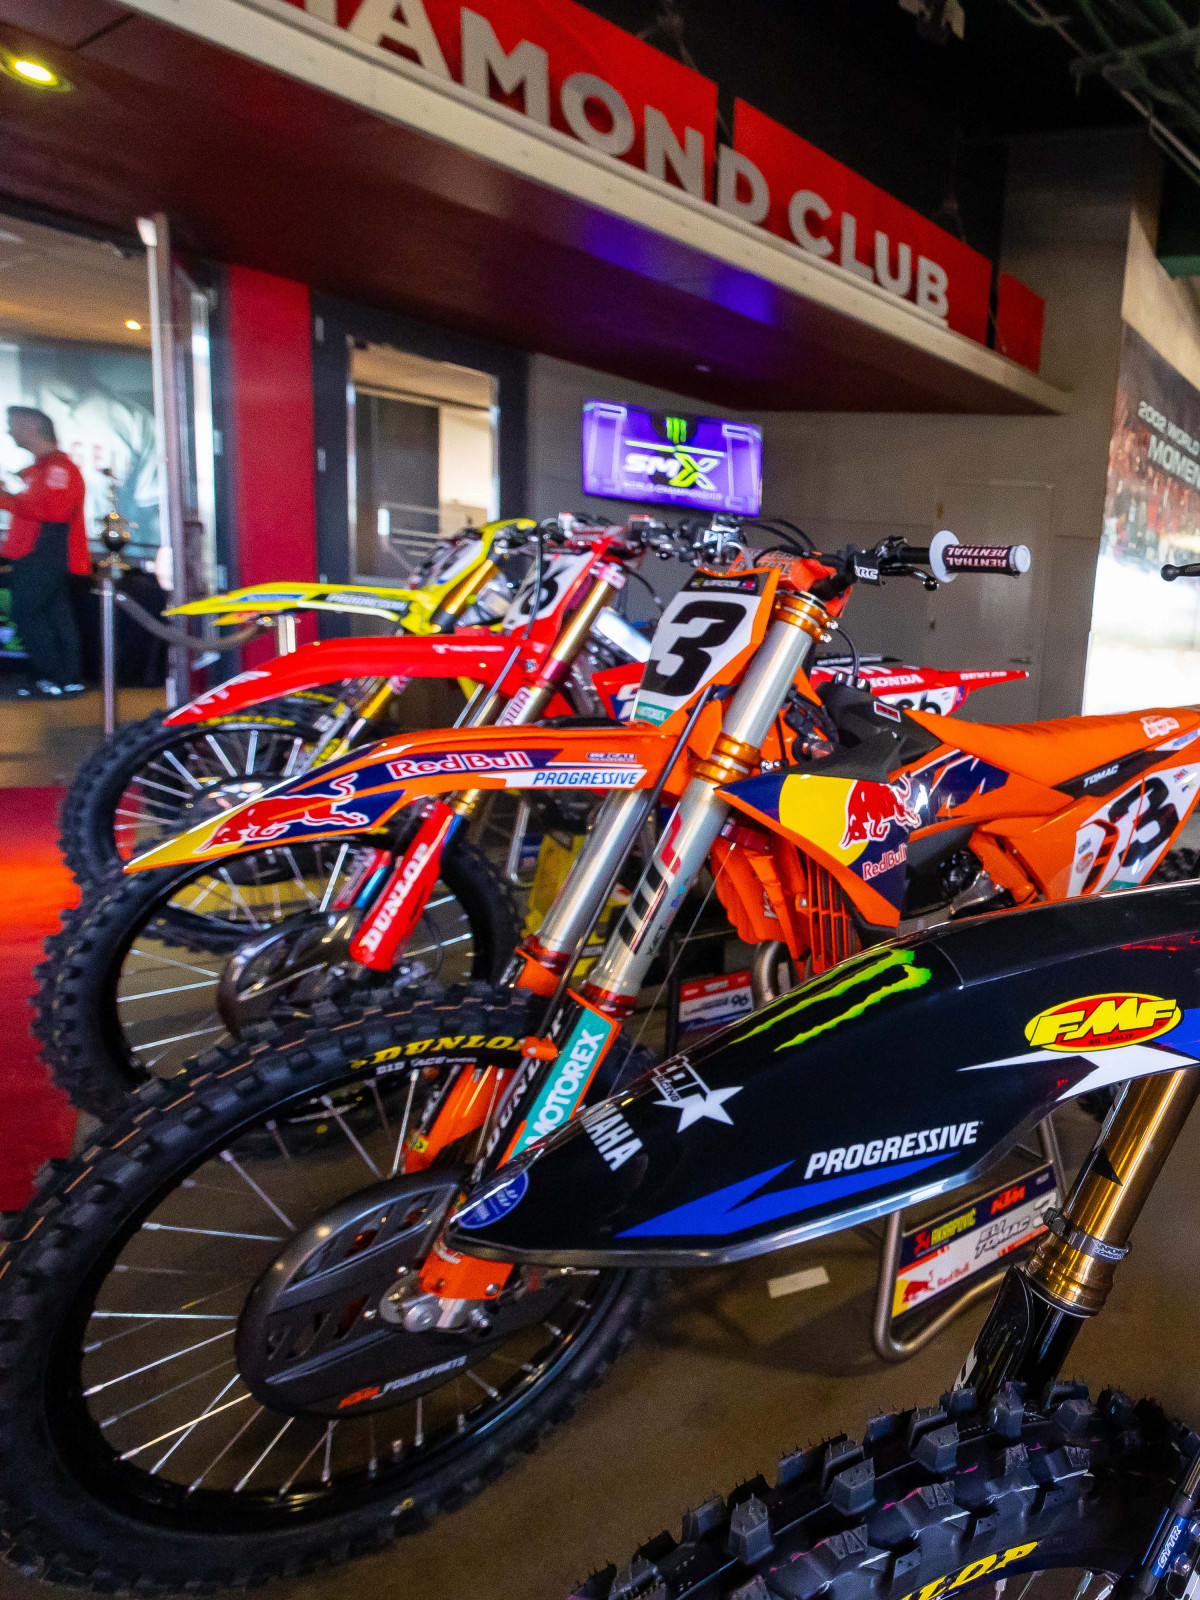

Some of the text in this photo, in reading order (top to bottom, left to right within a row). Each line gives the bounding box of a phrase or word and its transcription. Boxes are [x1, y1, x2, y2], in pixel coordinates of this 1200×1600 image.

[292, 0, 949, 319] AMOND CLUB
[624, 450, 721, 491] SMX
[946, 556, 1007, 568] RENTHAL
[649, 600, 747, 697] 3
[387, 751, 533, 779] Red Bull
[532, 772, 638, 785] PROGRESSIVE
[1082, 764, 1120, 788] TOMAC
[862, 842, 907, 881] Red Bull
[359, 842, 428, 952] DUNLOP
[1029, 997, 1177, 1047] FMF
[486, 1007, 564, 1158] DUNLP
[525, 1030, 605, 1146] MOTOREX
[804, 1121, 979, 1180] PROGRESSIVE
